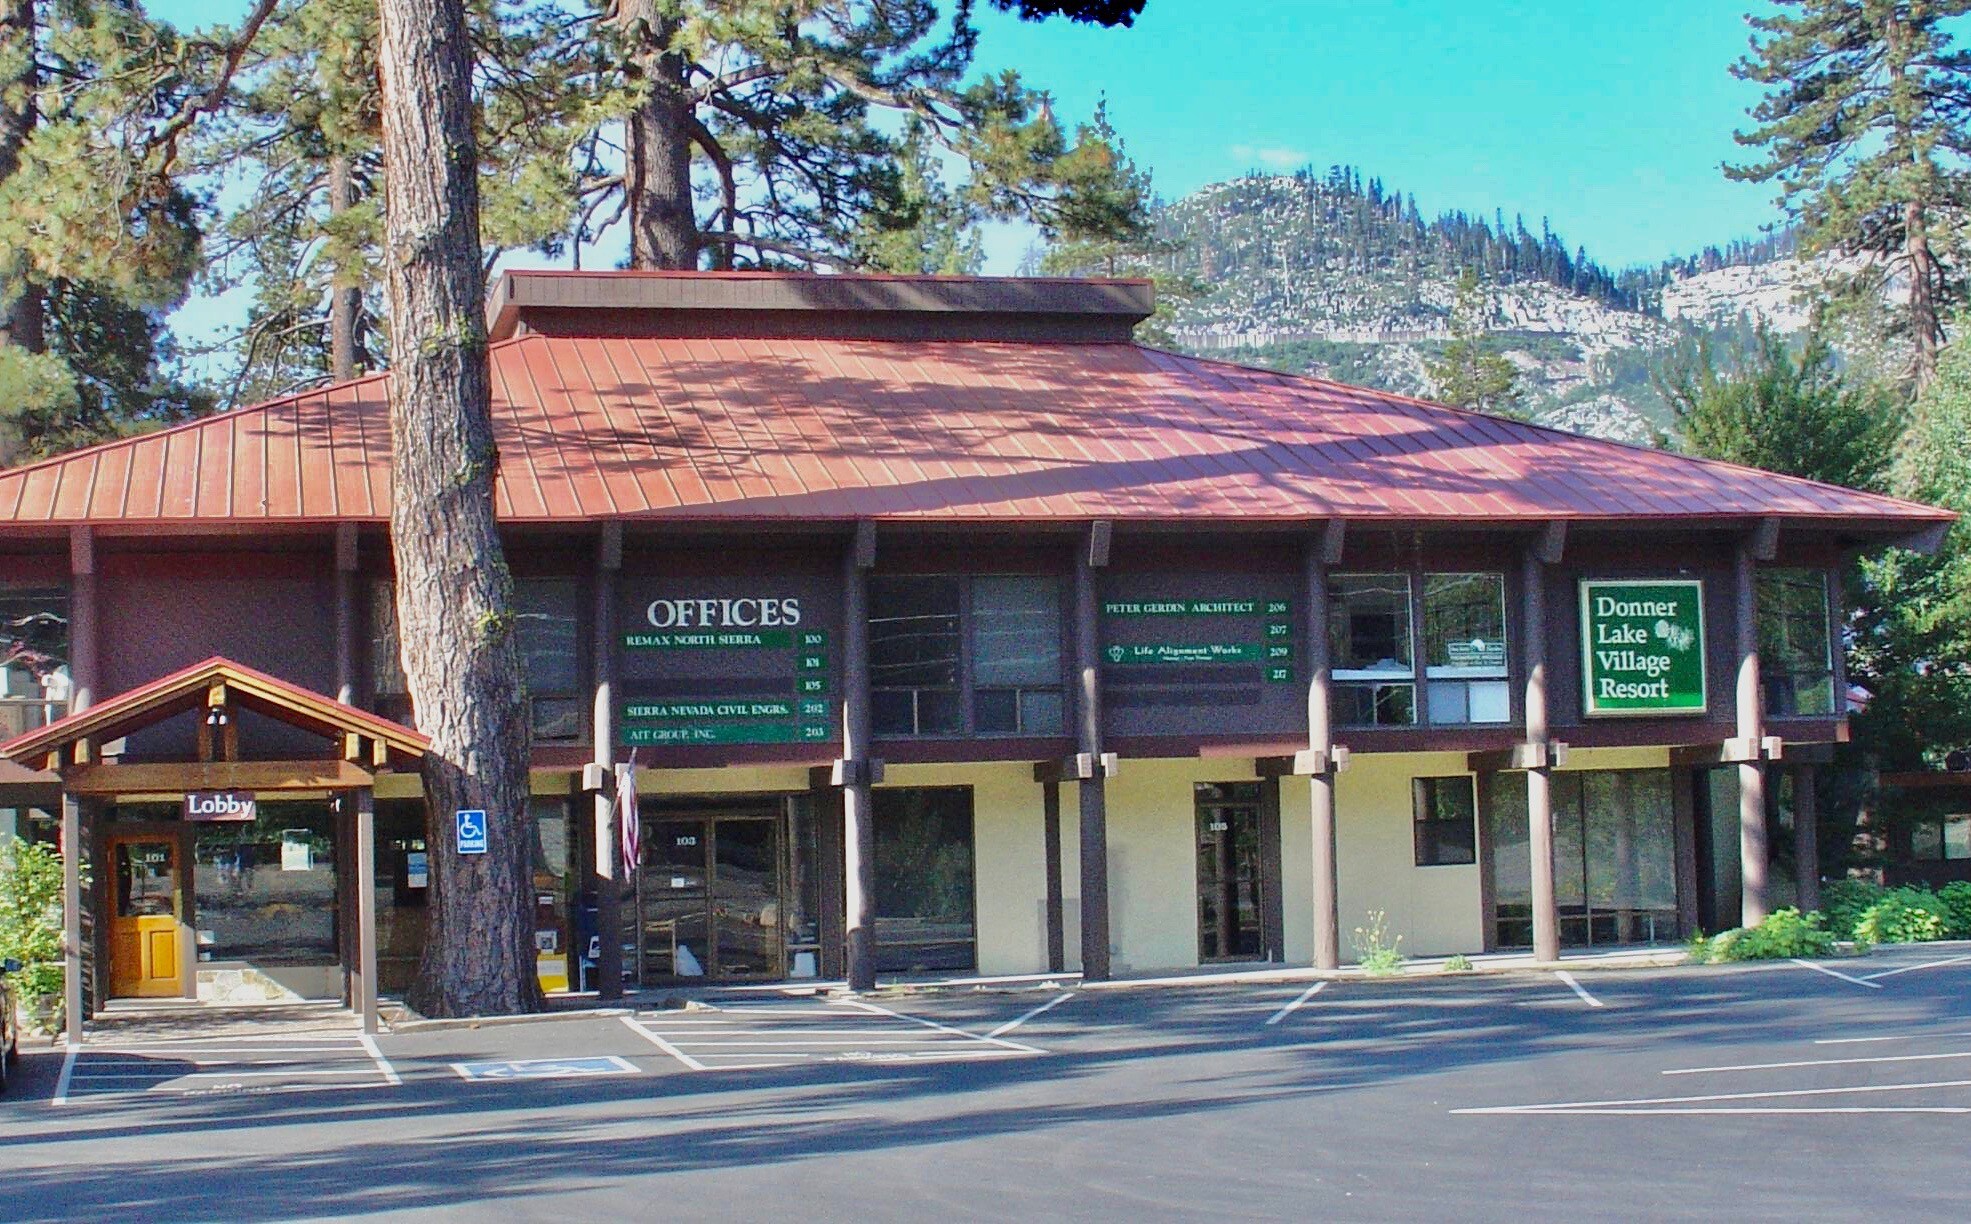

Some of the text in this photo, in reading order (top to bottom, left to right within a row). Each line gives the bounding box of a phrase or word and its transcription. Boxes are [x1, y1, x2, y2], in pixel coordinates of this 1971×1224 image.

[647, 598, 801, 628] OFFICES
[1105, 603, 1141, 614] PETER
[1191, 602, 1255, 613] ARCHITECT
[1269, 602, 1287, 613] 206
[1596, 597, 1678, 617] Donner
[1269, 625, 1287, 635] 207
[1597, 623, 1648, 644] Lake
[626, 634, 762, 646] REMAX NORTH SIERRA
[805, 634, 822, 645] 100
[1134, 644, 1242, 656] Life Alignment Works
[1269, 647, 1288, 657] 209
[805, 657, 820, 668] 101
[1596, 651, 1671, 677] Village
[805, 680, 821, 691] 105
[1599, 678, 1670, 699] Resort
[627, 704, 790, 716] SIERRA NEVADA CIVIL ENGRS.
[804, 703, 824, 713] 202
[693, 728, 717, 740] INC.
[804, 727, 824, 738] 203
[187, 794, 253, 819] Lobby
[676, 836, 697, 846] 103
[145, 852, 166, 862] 101
